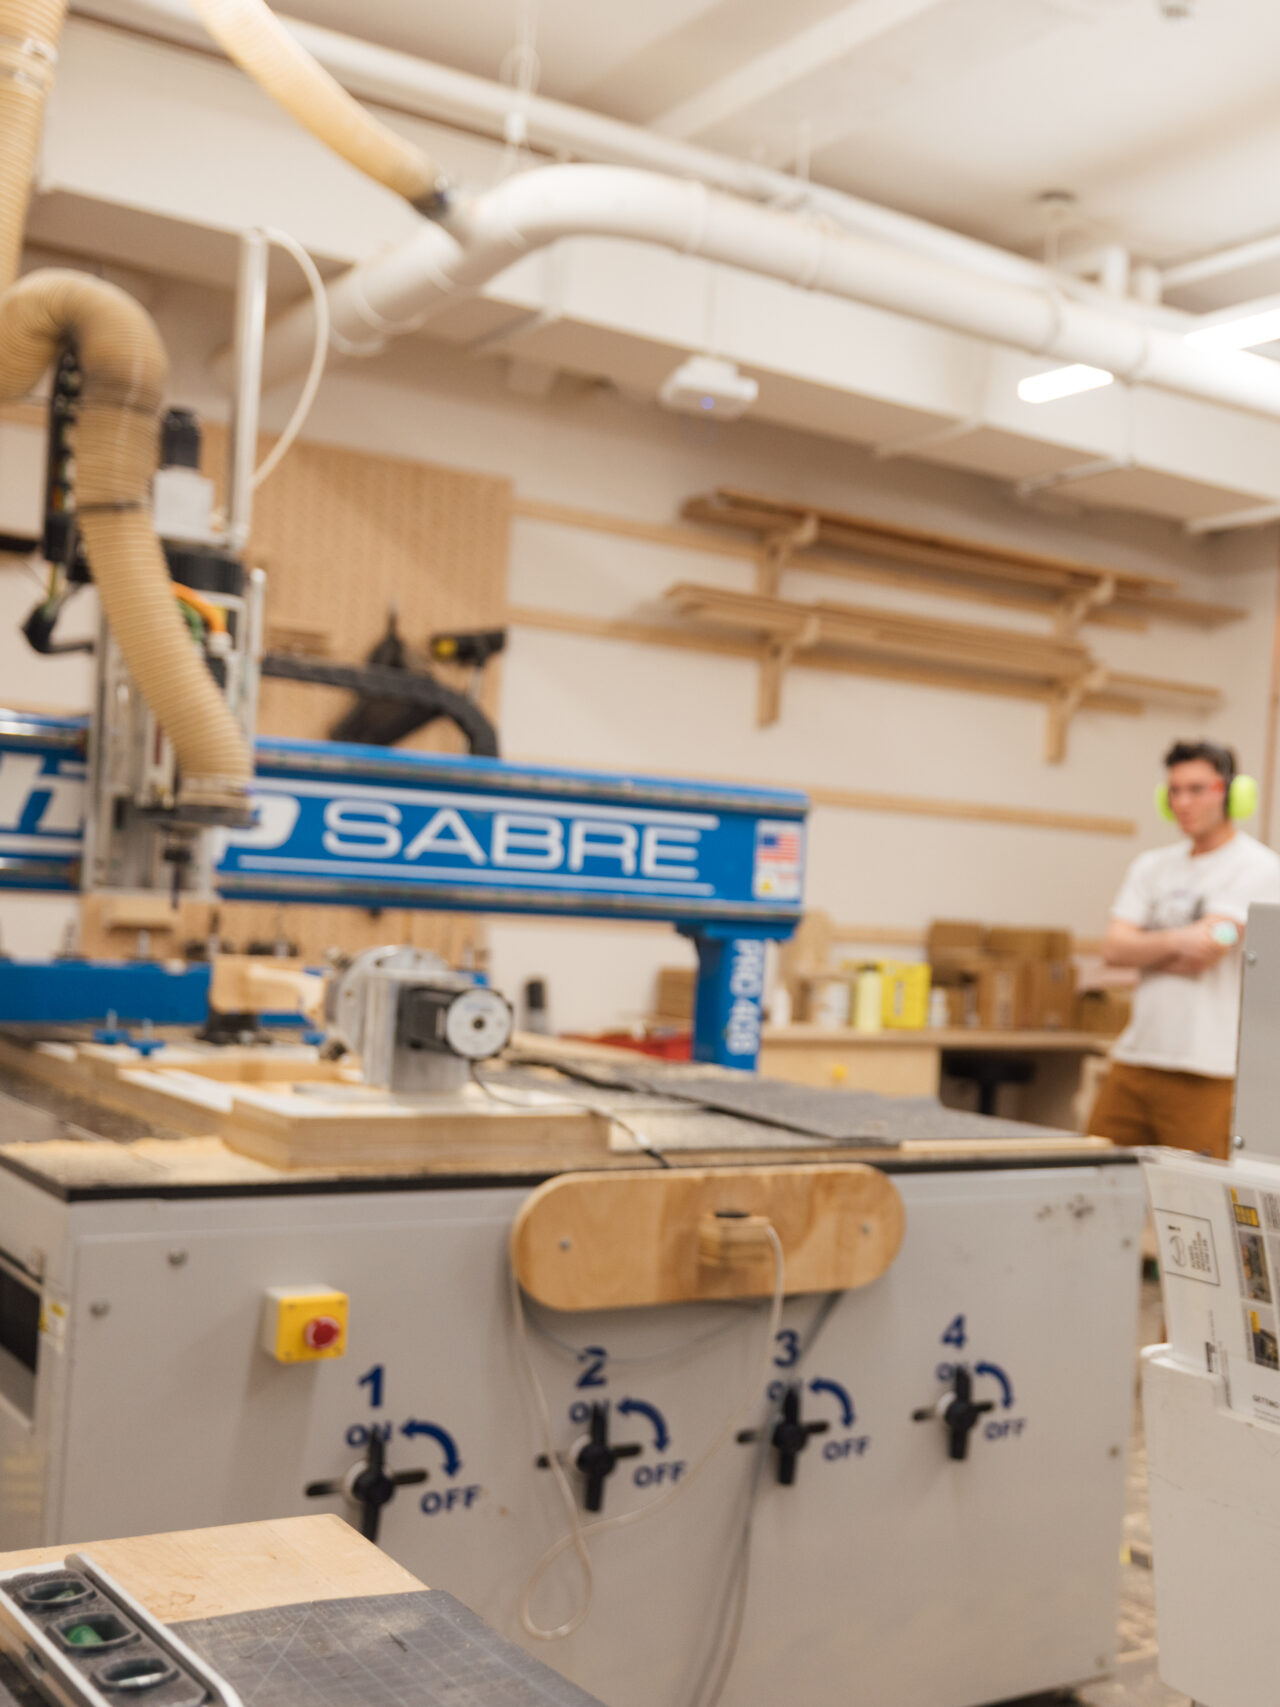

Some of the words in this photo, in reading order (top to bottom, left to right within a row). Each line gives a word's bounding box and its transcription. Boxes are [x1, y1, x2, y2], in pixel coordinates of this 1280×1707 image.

[321, 799, 701, 881] SABRE
[729, 938, 766, 999] PRO
[772, 1329, 802, 1369] 3
[941, 1313, 967, 1349] 4
[575, 1345, 609, 1389] 2
[936, 1362, 970, 1383] O
[357, 1364, 385, 1408] 1
[983, 1418, 1027, 1441] OFF
[822, 1434, 870, 1462] OFF
[633, 1460, 687, 1488] OFF
[420, 1485, 481, 1516] OFF
